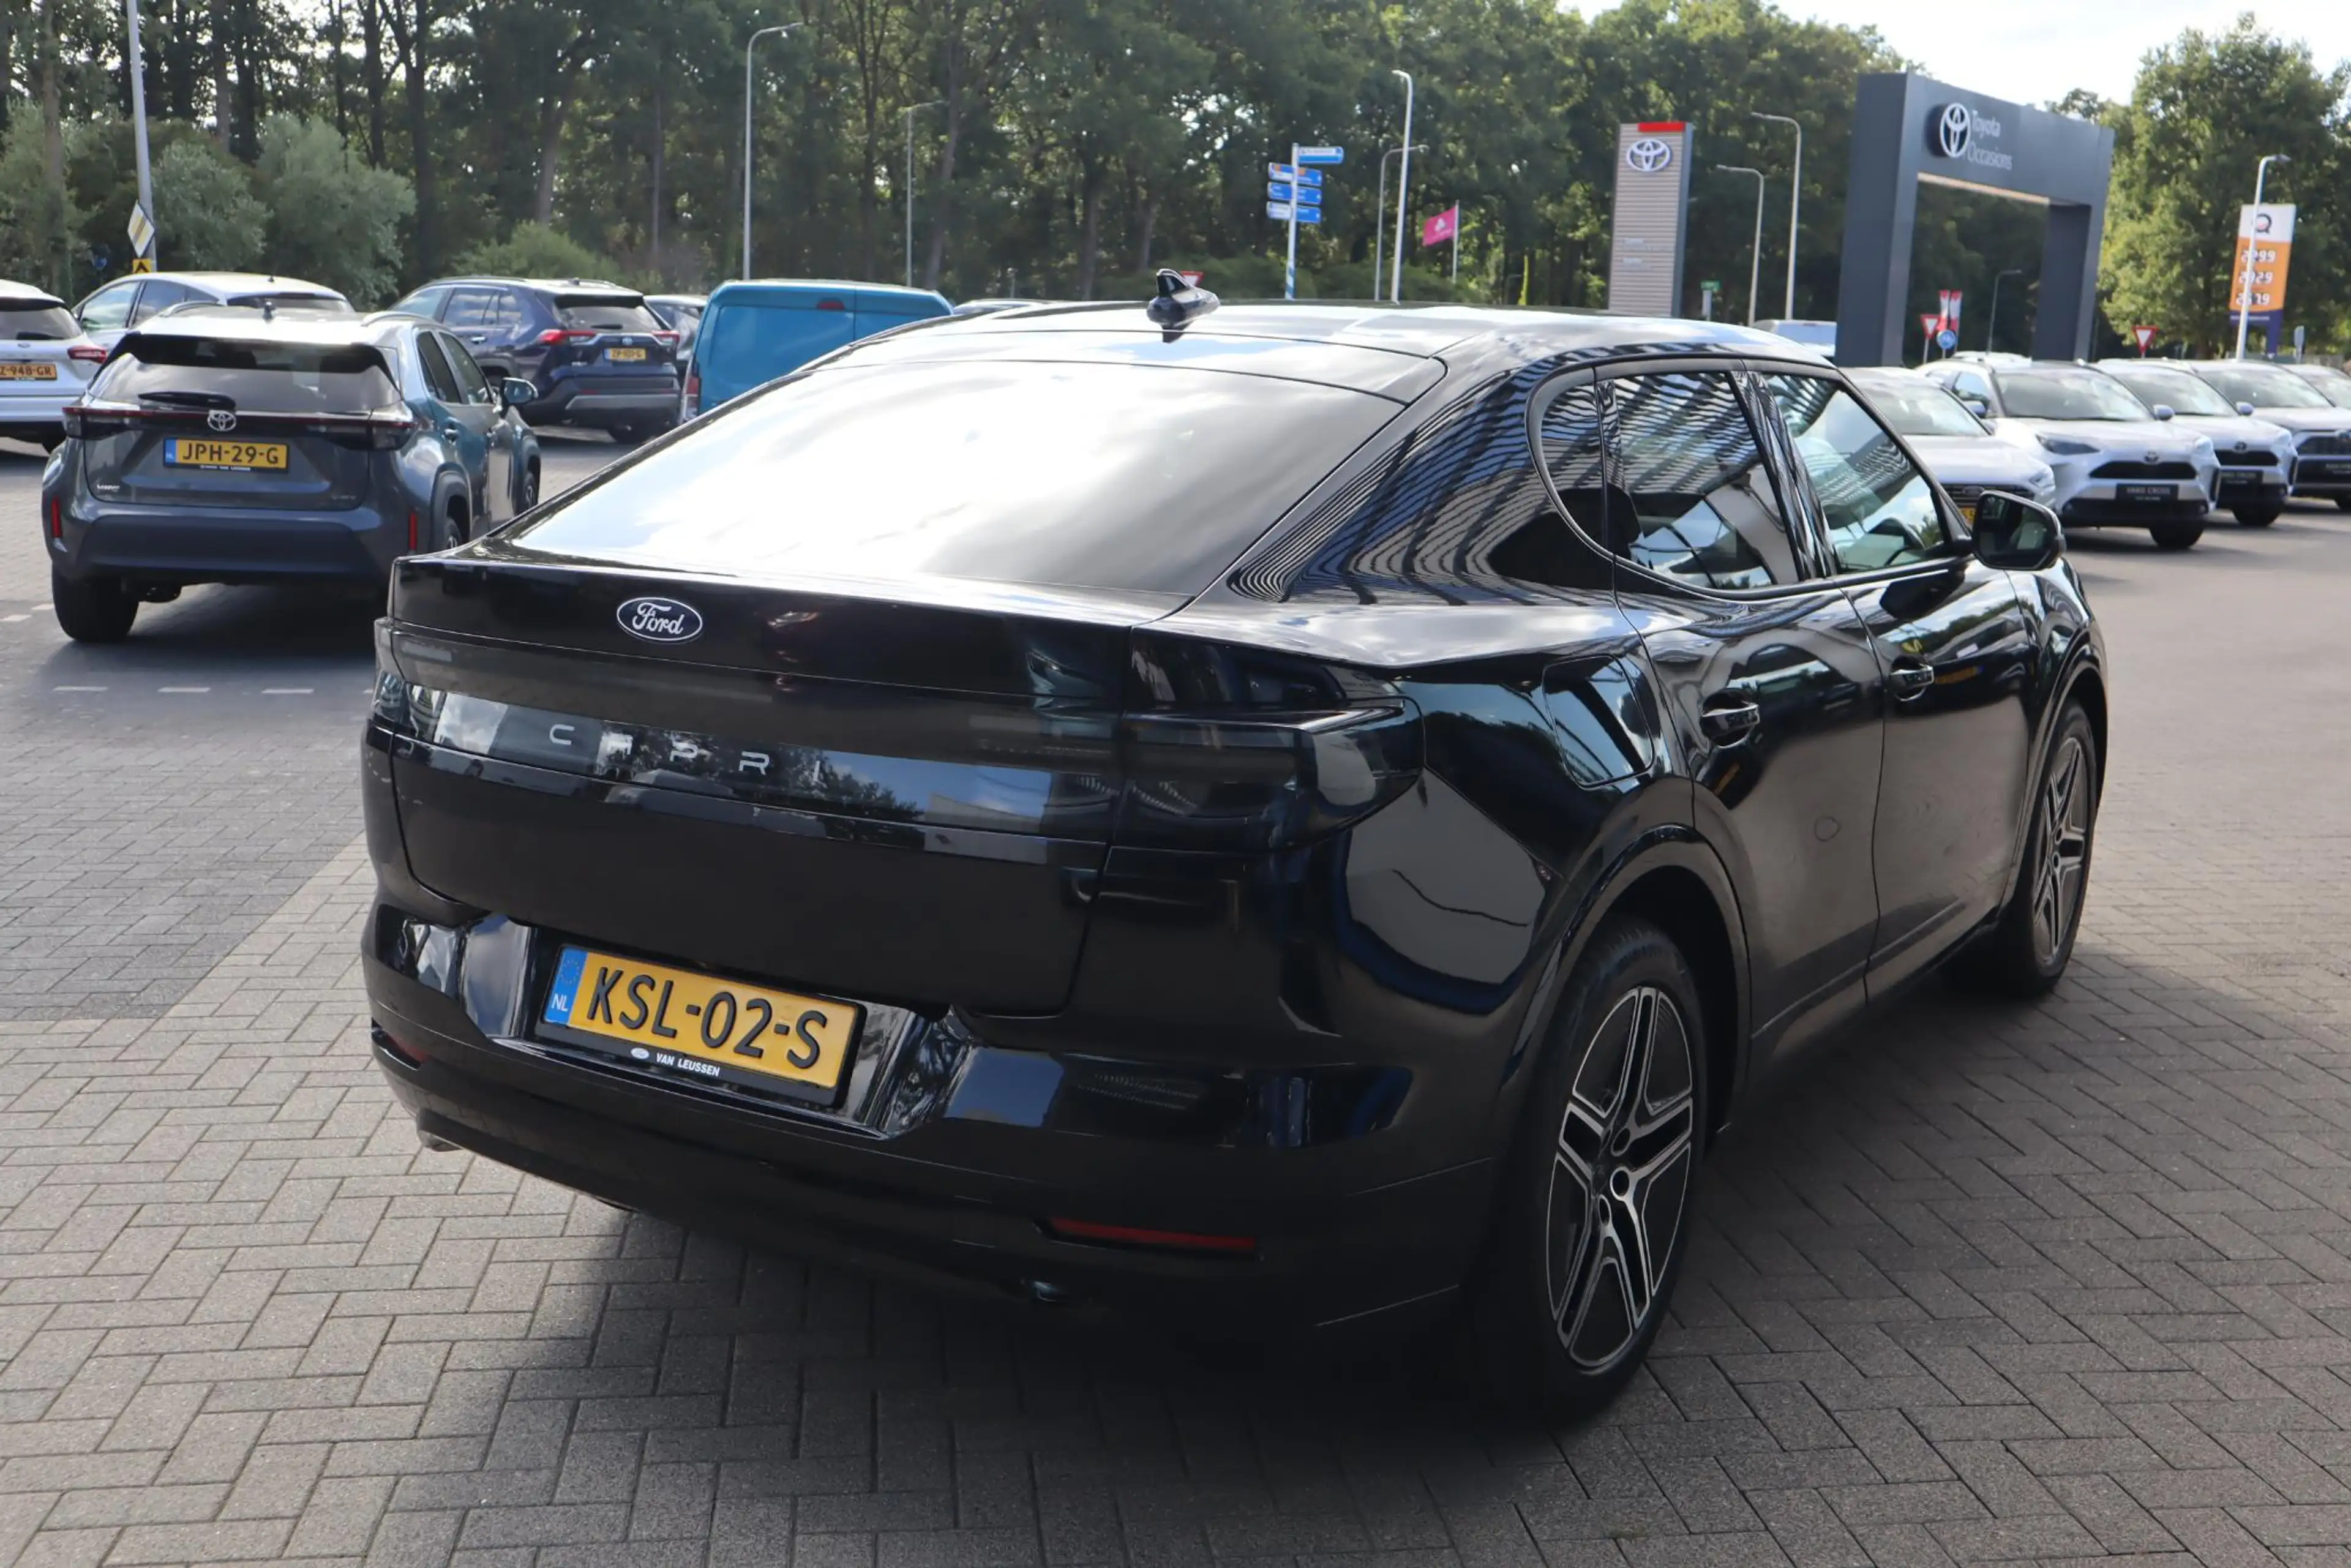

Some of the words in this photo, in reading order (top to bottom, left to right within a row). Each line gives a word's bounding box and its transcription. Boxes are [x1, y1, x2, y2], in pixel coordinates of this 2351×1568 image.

[1972, 110, 2000, 139] Toyota
[1967, 141, 2012, 171] Occasions
[183, 443, 279, 465] JPH-29-G
[632, 602, 684, 634] Ford
[551, 993, 569, 1012] NL
[587, 966, 828, 1070] KSL-02-S
[656, 1052, 675, 1066] VAN
[677, 1058, 721, 1077] LEUSSEN
